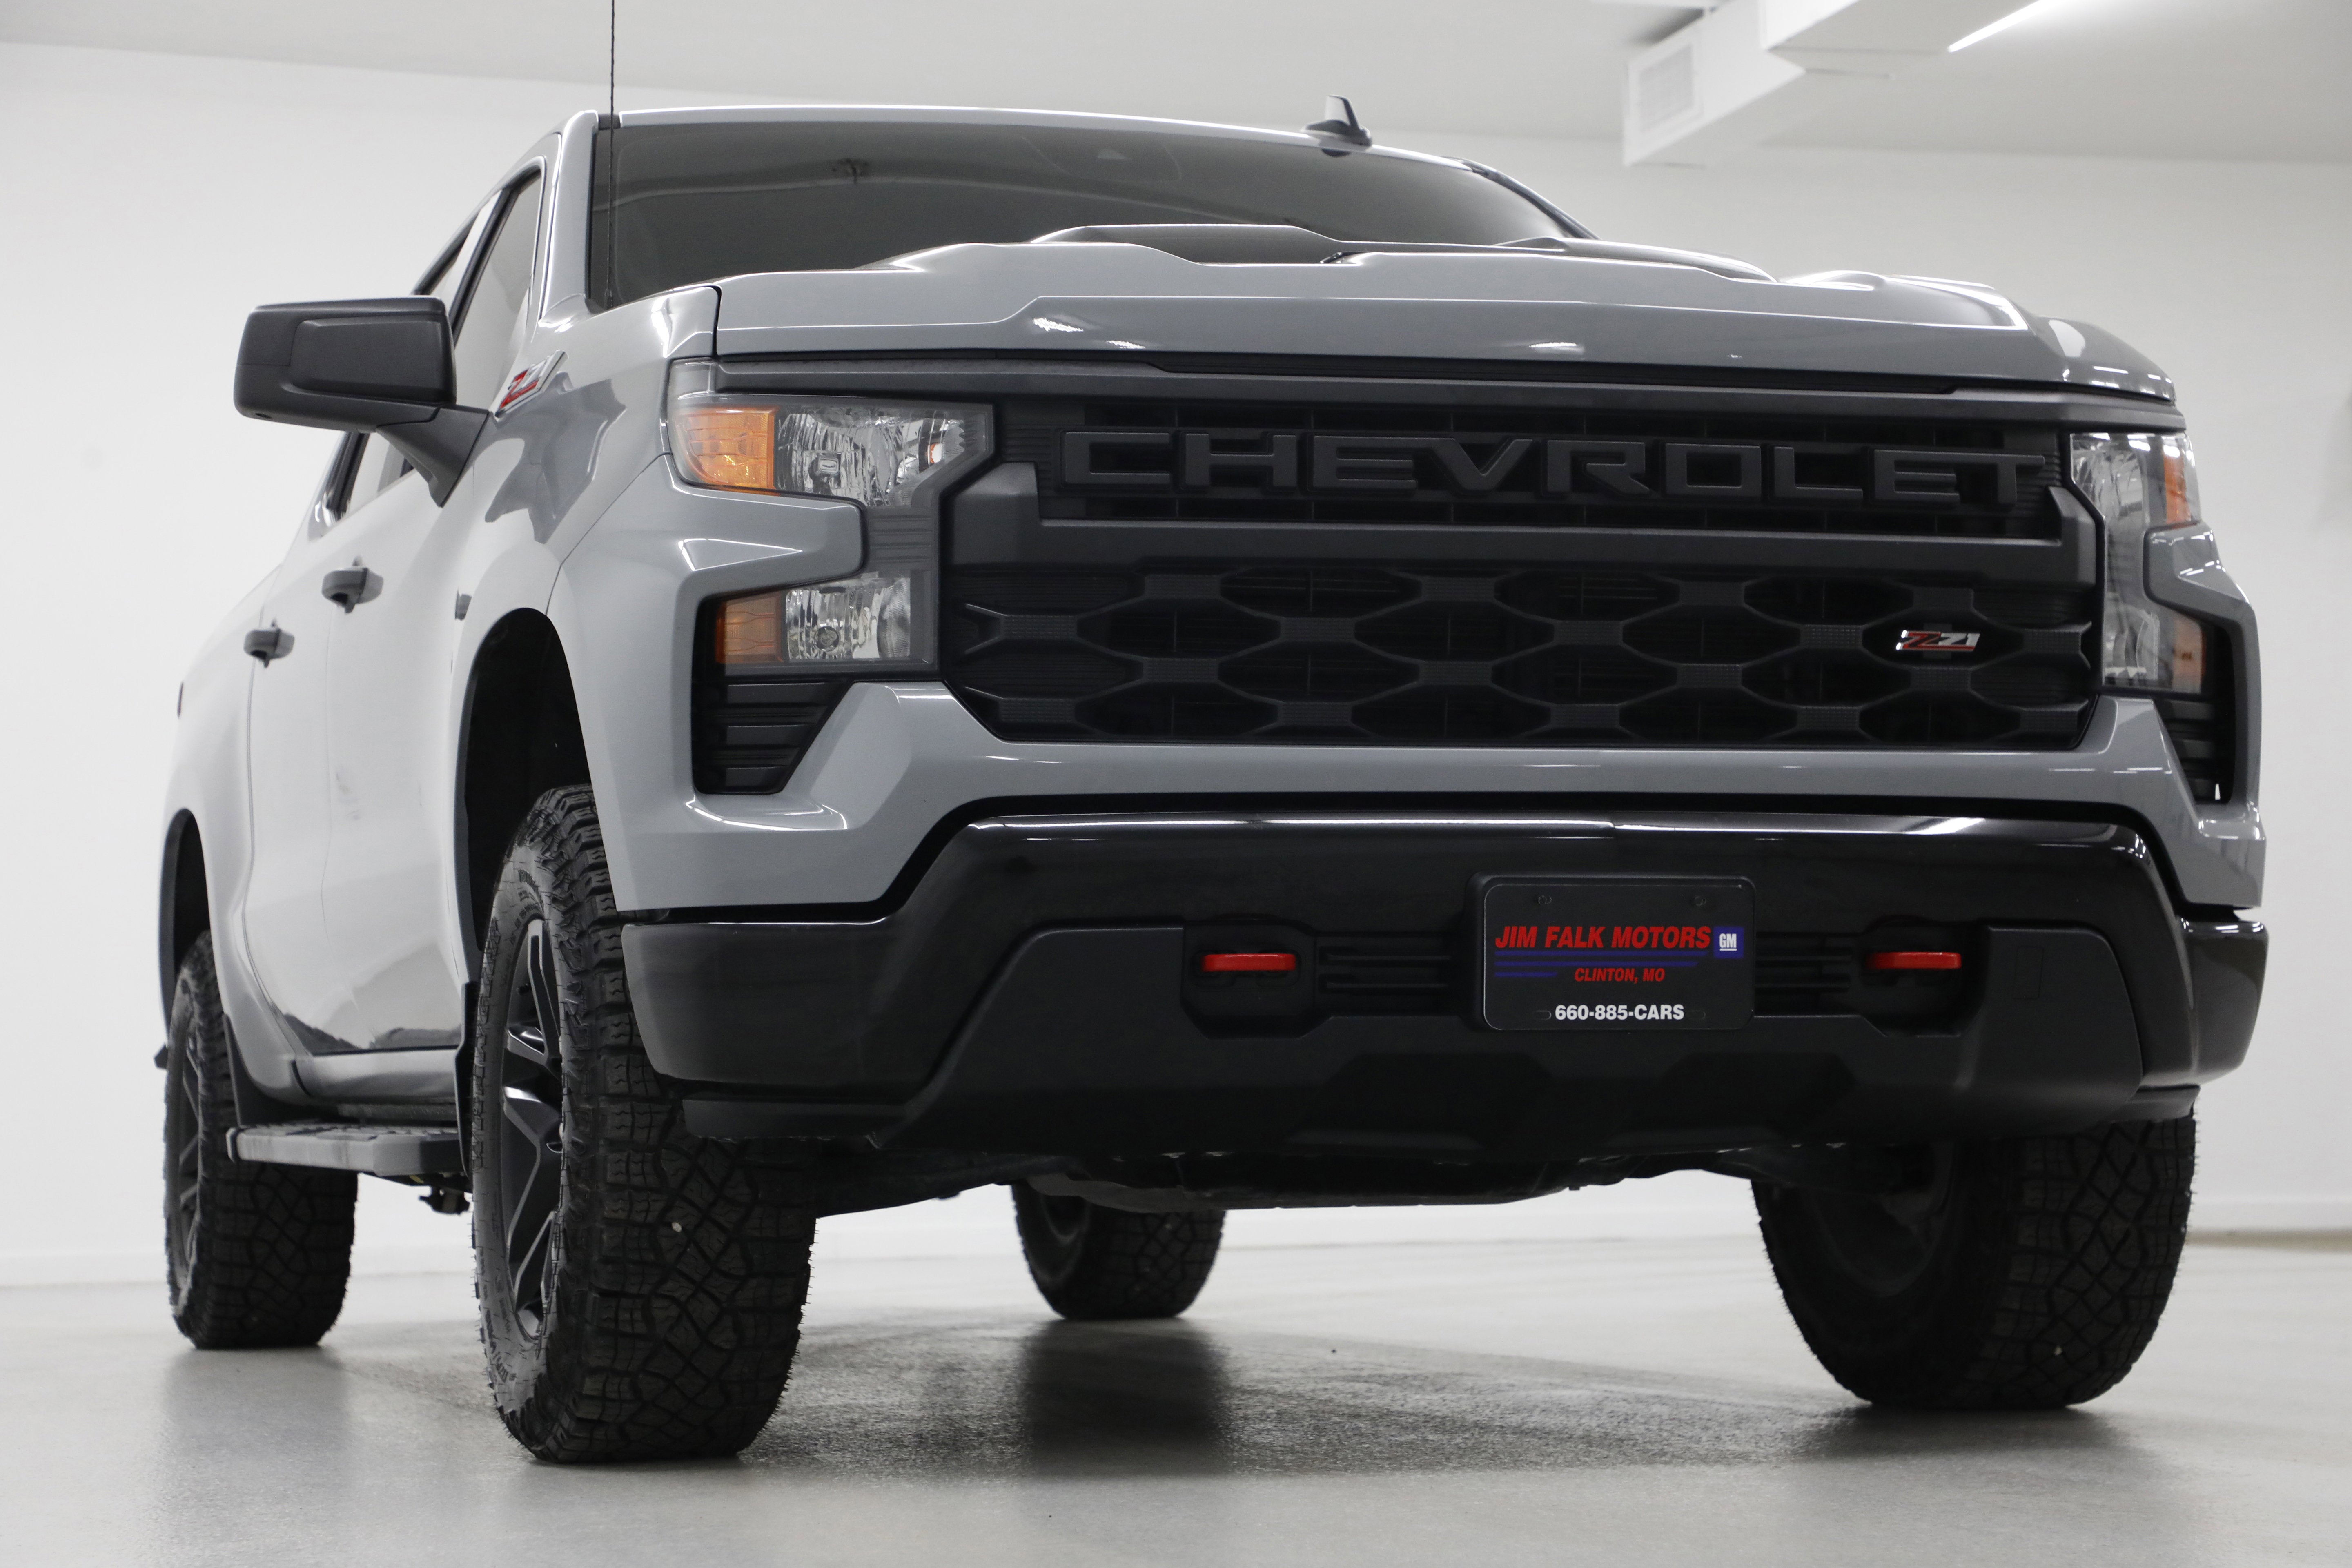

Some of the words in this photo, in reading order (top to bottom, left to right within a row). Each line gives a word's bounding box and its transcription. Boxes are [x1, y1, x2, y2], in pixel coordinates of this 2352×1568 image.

[1064, 431, 2046, 508] CHEVROLET
[1896, 630, 1980, 651] Z71
[1495, 926, 1538, 948] JIM
[1545, 926, 1606, 948] FALK
[1611, 926, 1711, 949] MOTORS
[1719, 933, 1737, 949] GM
[1574, 967, 1638, 984] CLINTON,
[1643, 967, 1666, 982] MO
[1555, 1004, 1684, 1020] 660-885-CARS
